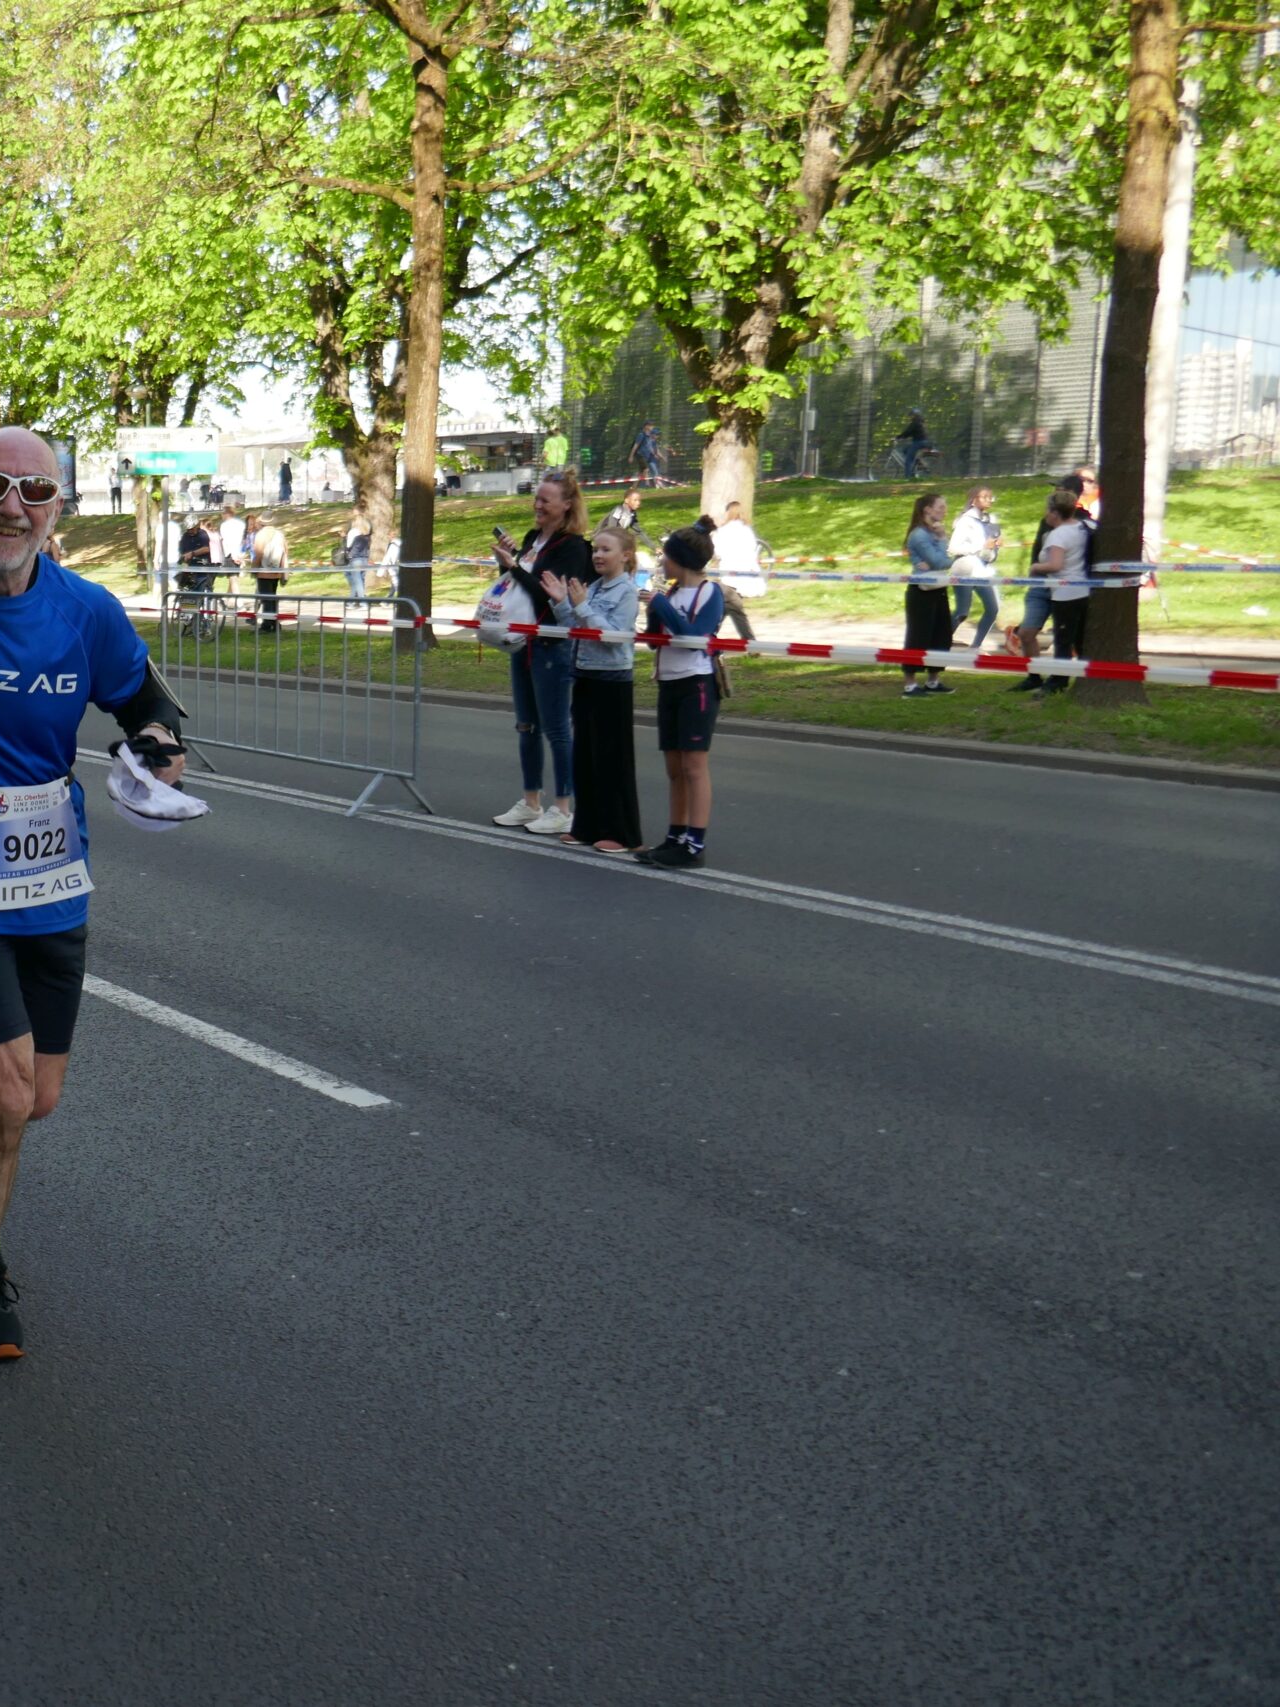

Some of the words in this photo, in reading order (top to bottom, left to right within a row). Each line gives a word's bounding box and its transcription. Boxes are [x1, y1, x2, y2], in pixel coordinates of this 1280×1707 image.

[27, 673, 78, 694] AG
[29, 818, 51, 828] Franz
[3, 828, 66, 862] 9022
[50, 873, 82, 895] AG
